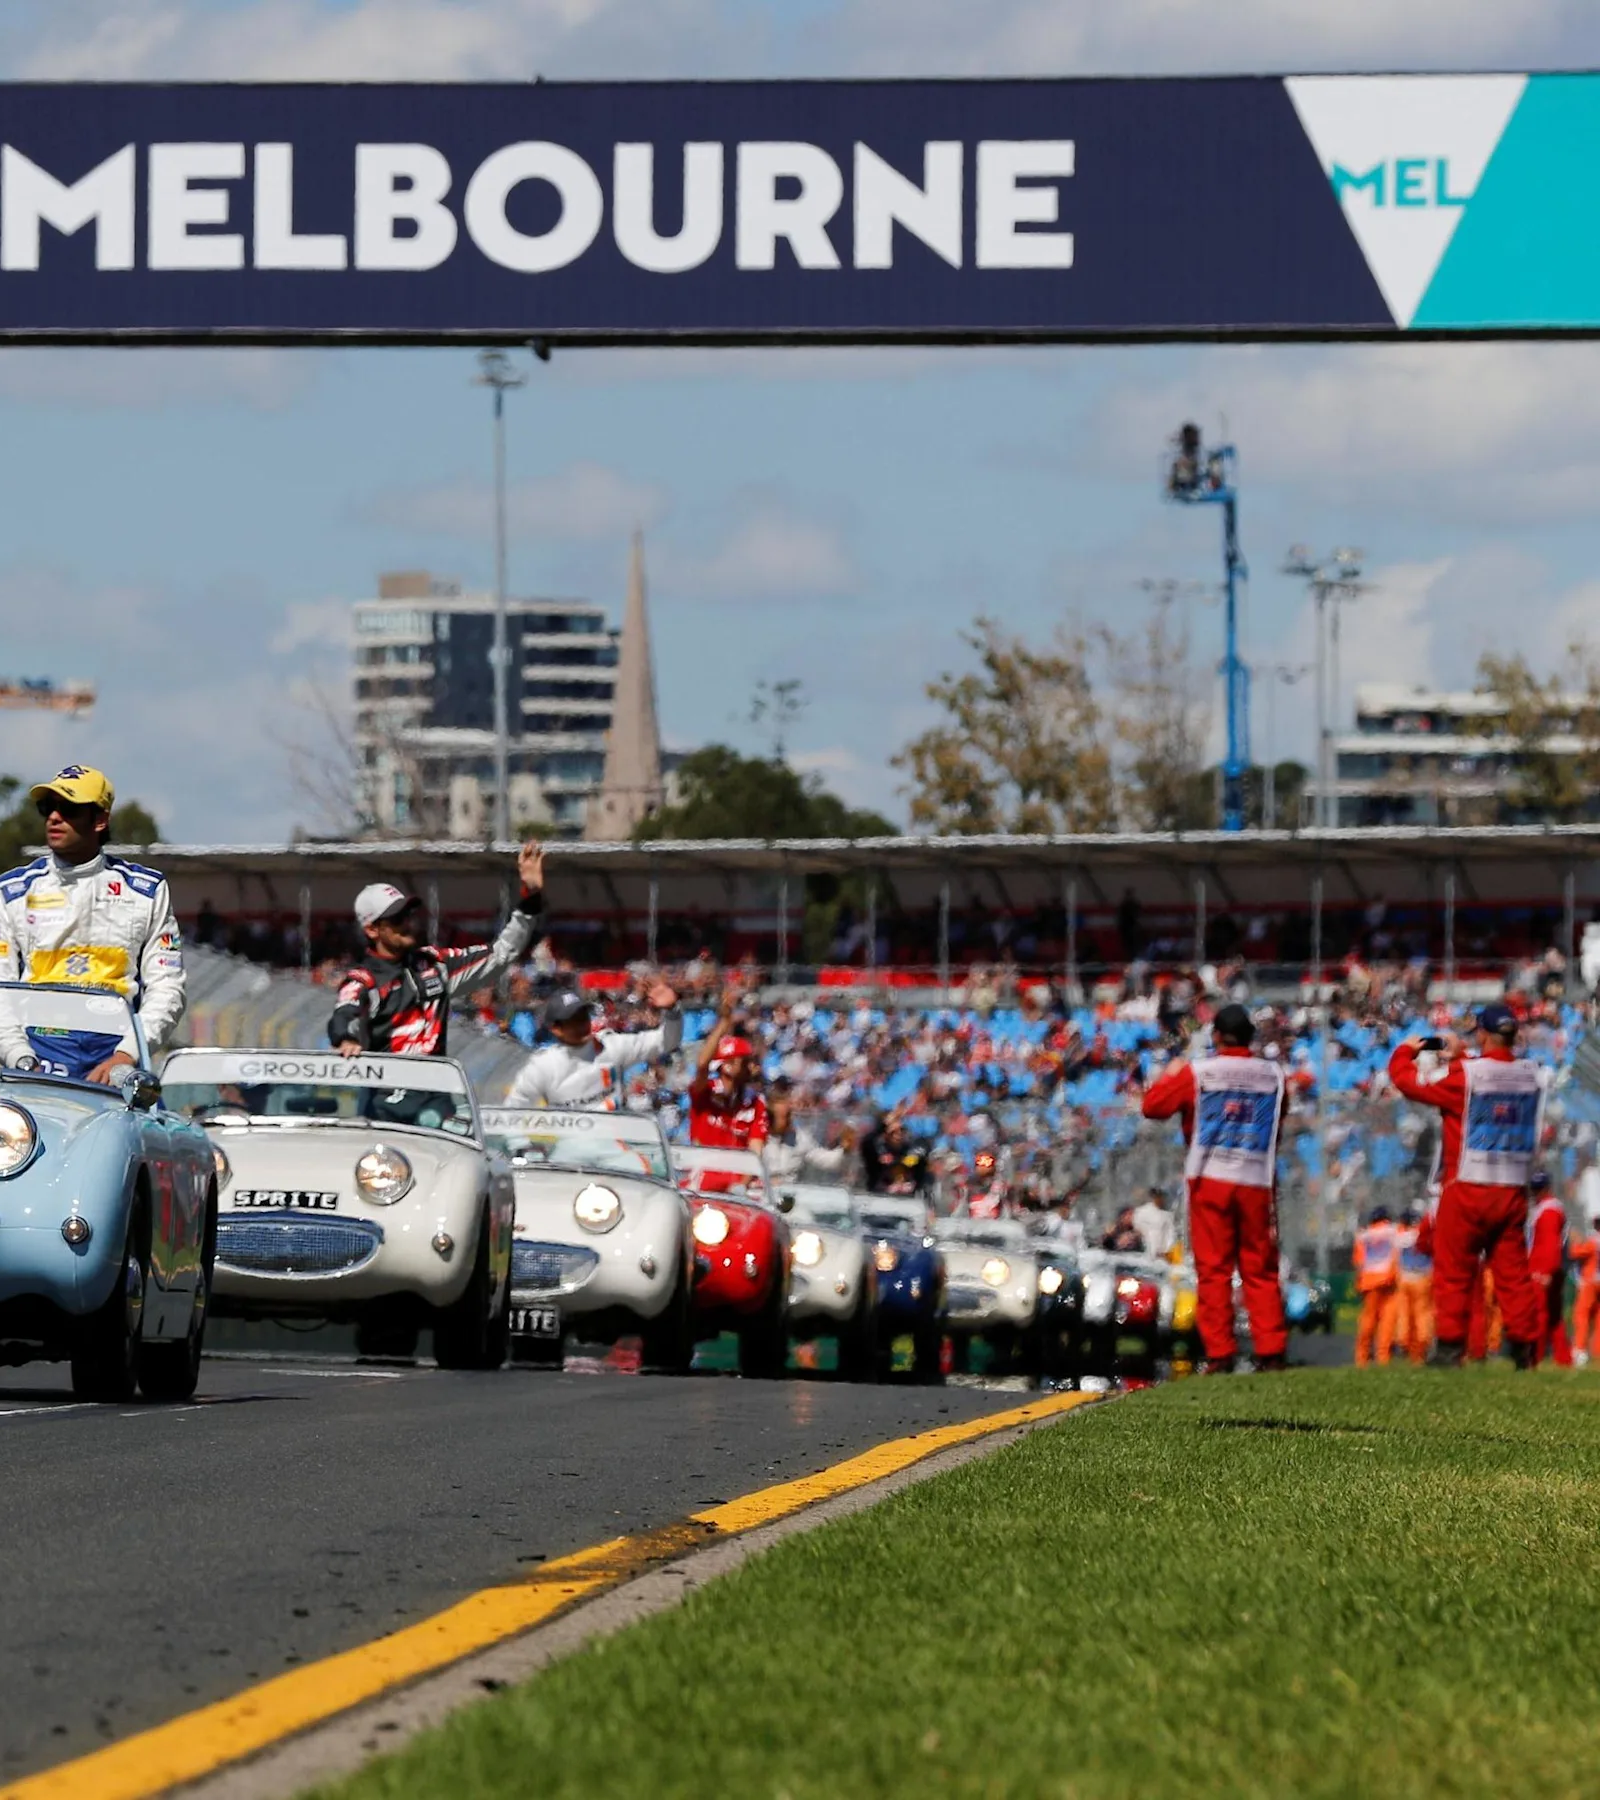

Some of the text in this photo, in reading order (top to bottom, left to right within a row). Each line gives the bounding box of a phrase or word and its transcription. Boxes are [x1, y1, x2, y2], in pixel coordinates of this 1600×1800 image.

[1332, 159, 1471, 207] MEL
[1, 140, 1075, 272] MELBOURNE
[240, 1061, 384, 1080] GROSJEAN
[236, 1191, 337, 1209] SPRITE
